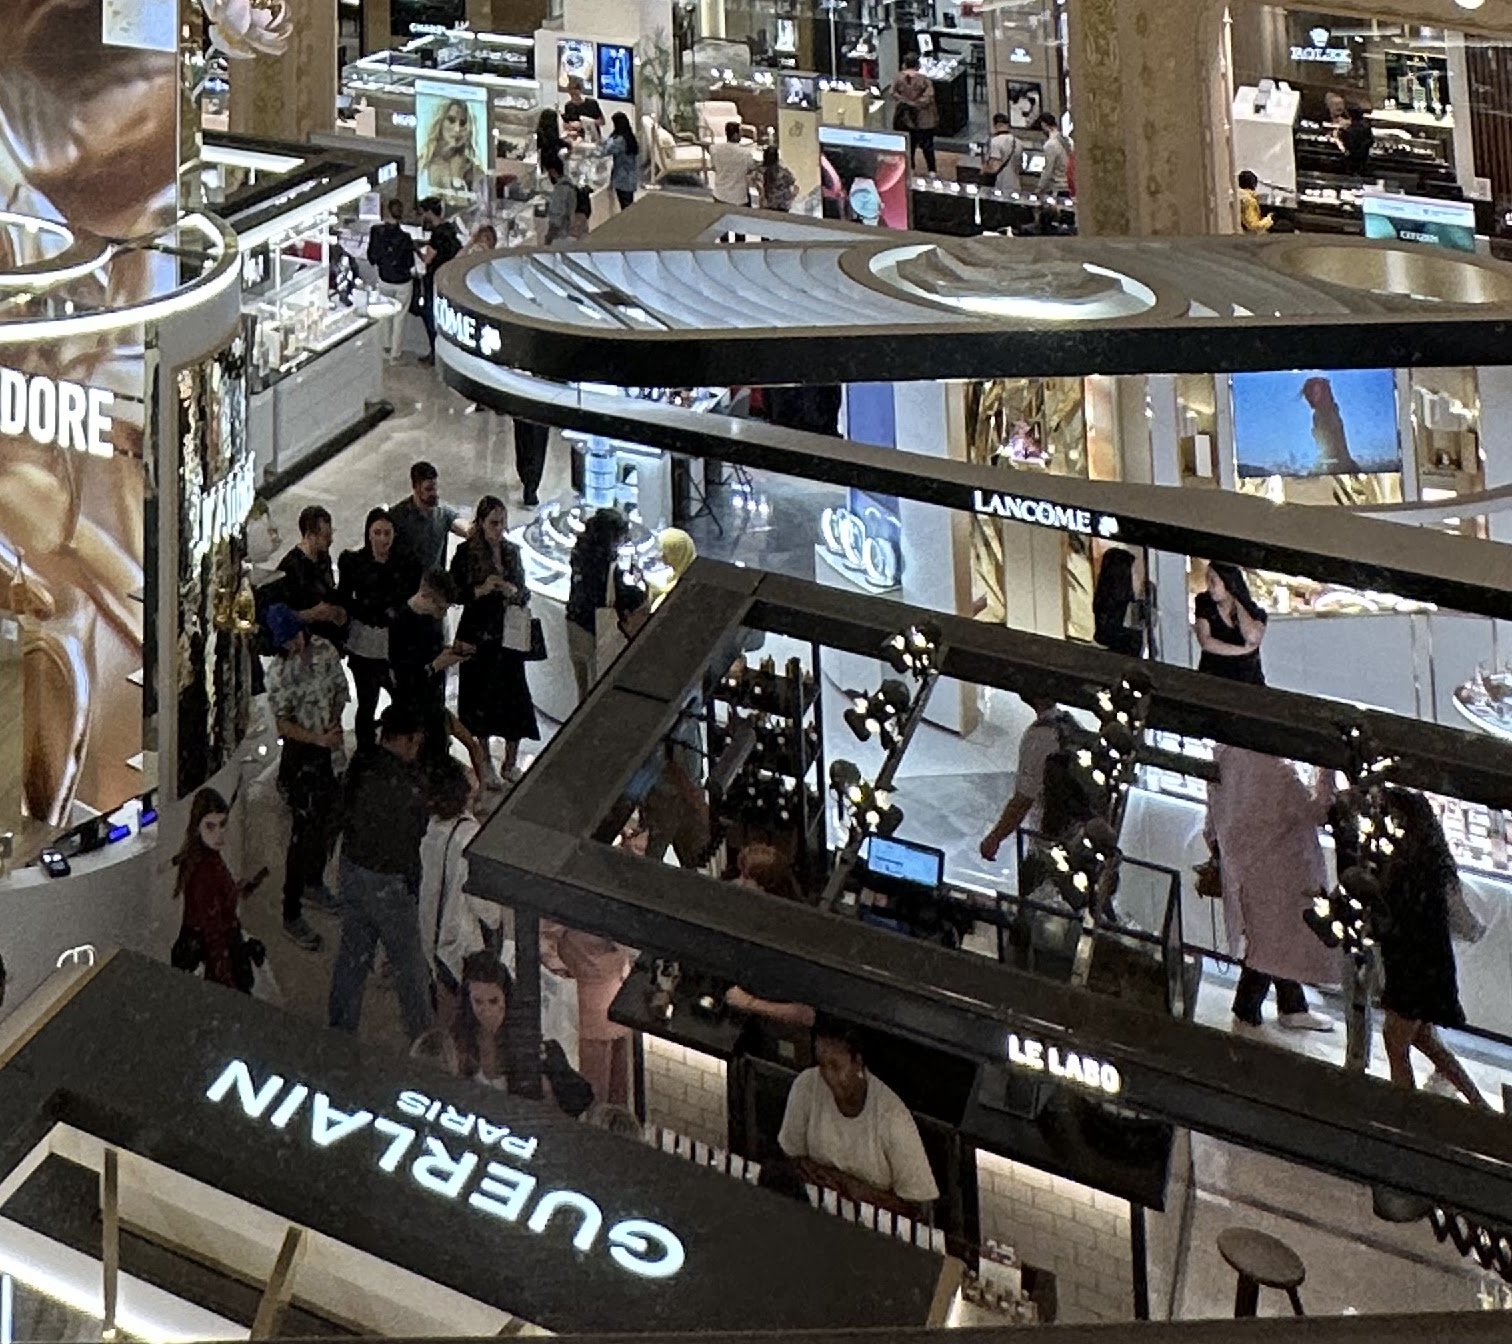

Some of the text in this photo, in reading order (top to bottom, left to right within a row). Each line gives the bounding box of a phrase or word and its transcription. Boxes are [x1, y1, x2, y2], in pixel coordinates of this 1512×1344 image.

[1007, 1034, 1121, 1094] LE LABO
[395, 1089, 541, 1160] PARIS
[204, 1057, 687, 1279] GUERLAIN
